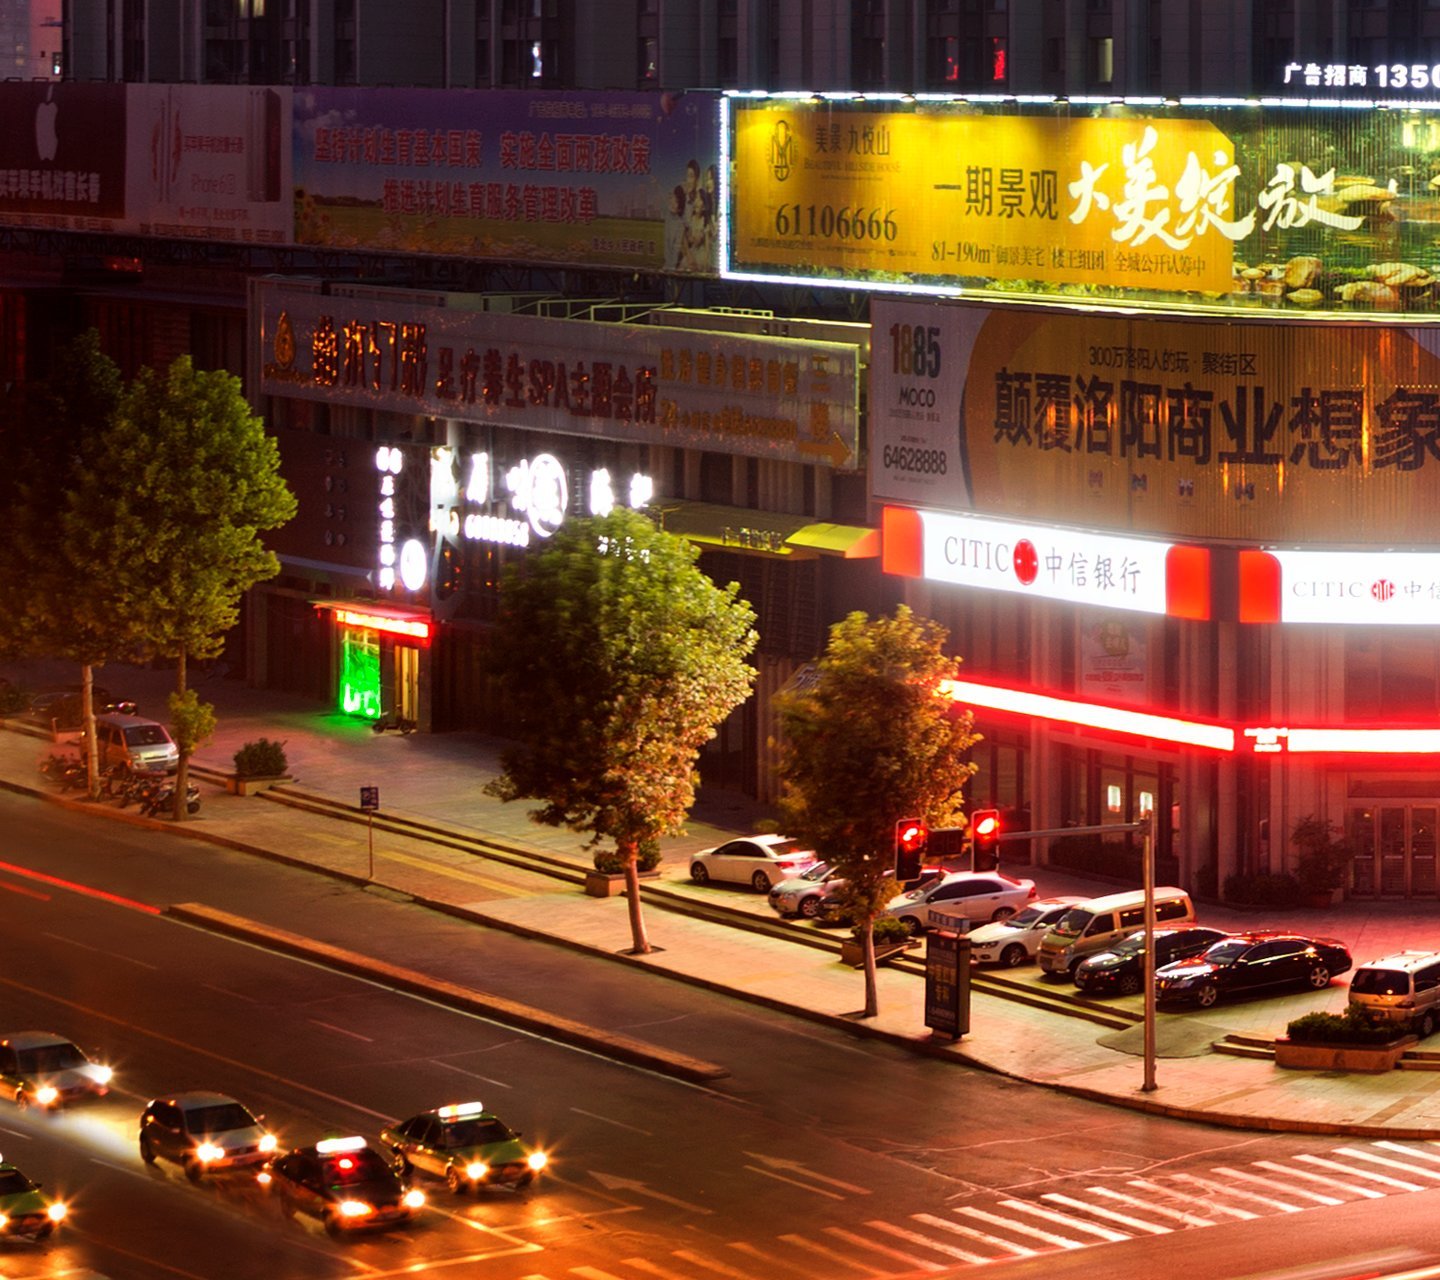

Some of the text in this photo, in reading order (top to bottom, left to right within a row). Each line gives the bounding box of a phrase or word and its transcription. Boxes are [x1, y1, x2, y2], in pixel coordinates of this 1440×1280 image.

[1283, 62, 1368, 87] 广告招商
[314, 126, 652, 176] 坚持计划生育基本国策 实施全面两孩政策
[382, 178, 599, 225] 推进计划生育服务管理改革
[933, 164, 1059, 221] 一期景观
[776, 203, 898, 242] 61106666
[889, 322, 942, 379] 1885
[898, 386, 936, 409] MOCO
[883, 443, 948, 476] 64628888
[944, 535, 1142, 595] CITIC 中信银行
[1292, 580, 1364, 599] CITIC
